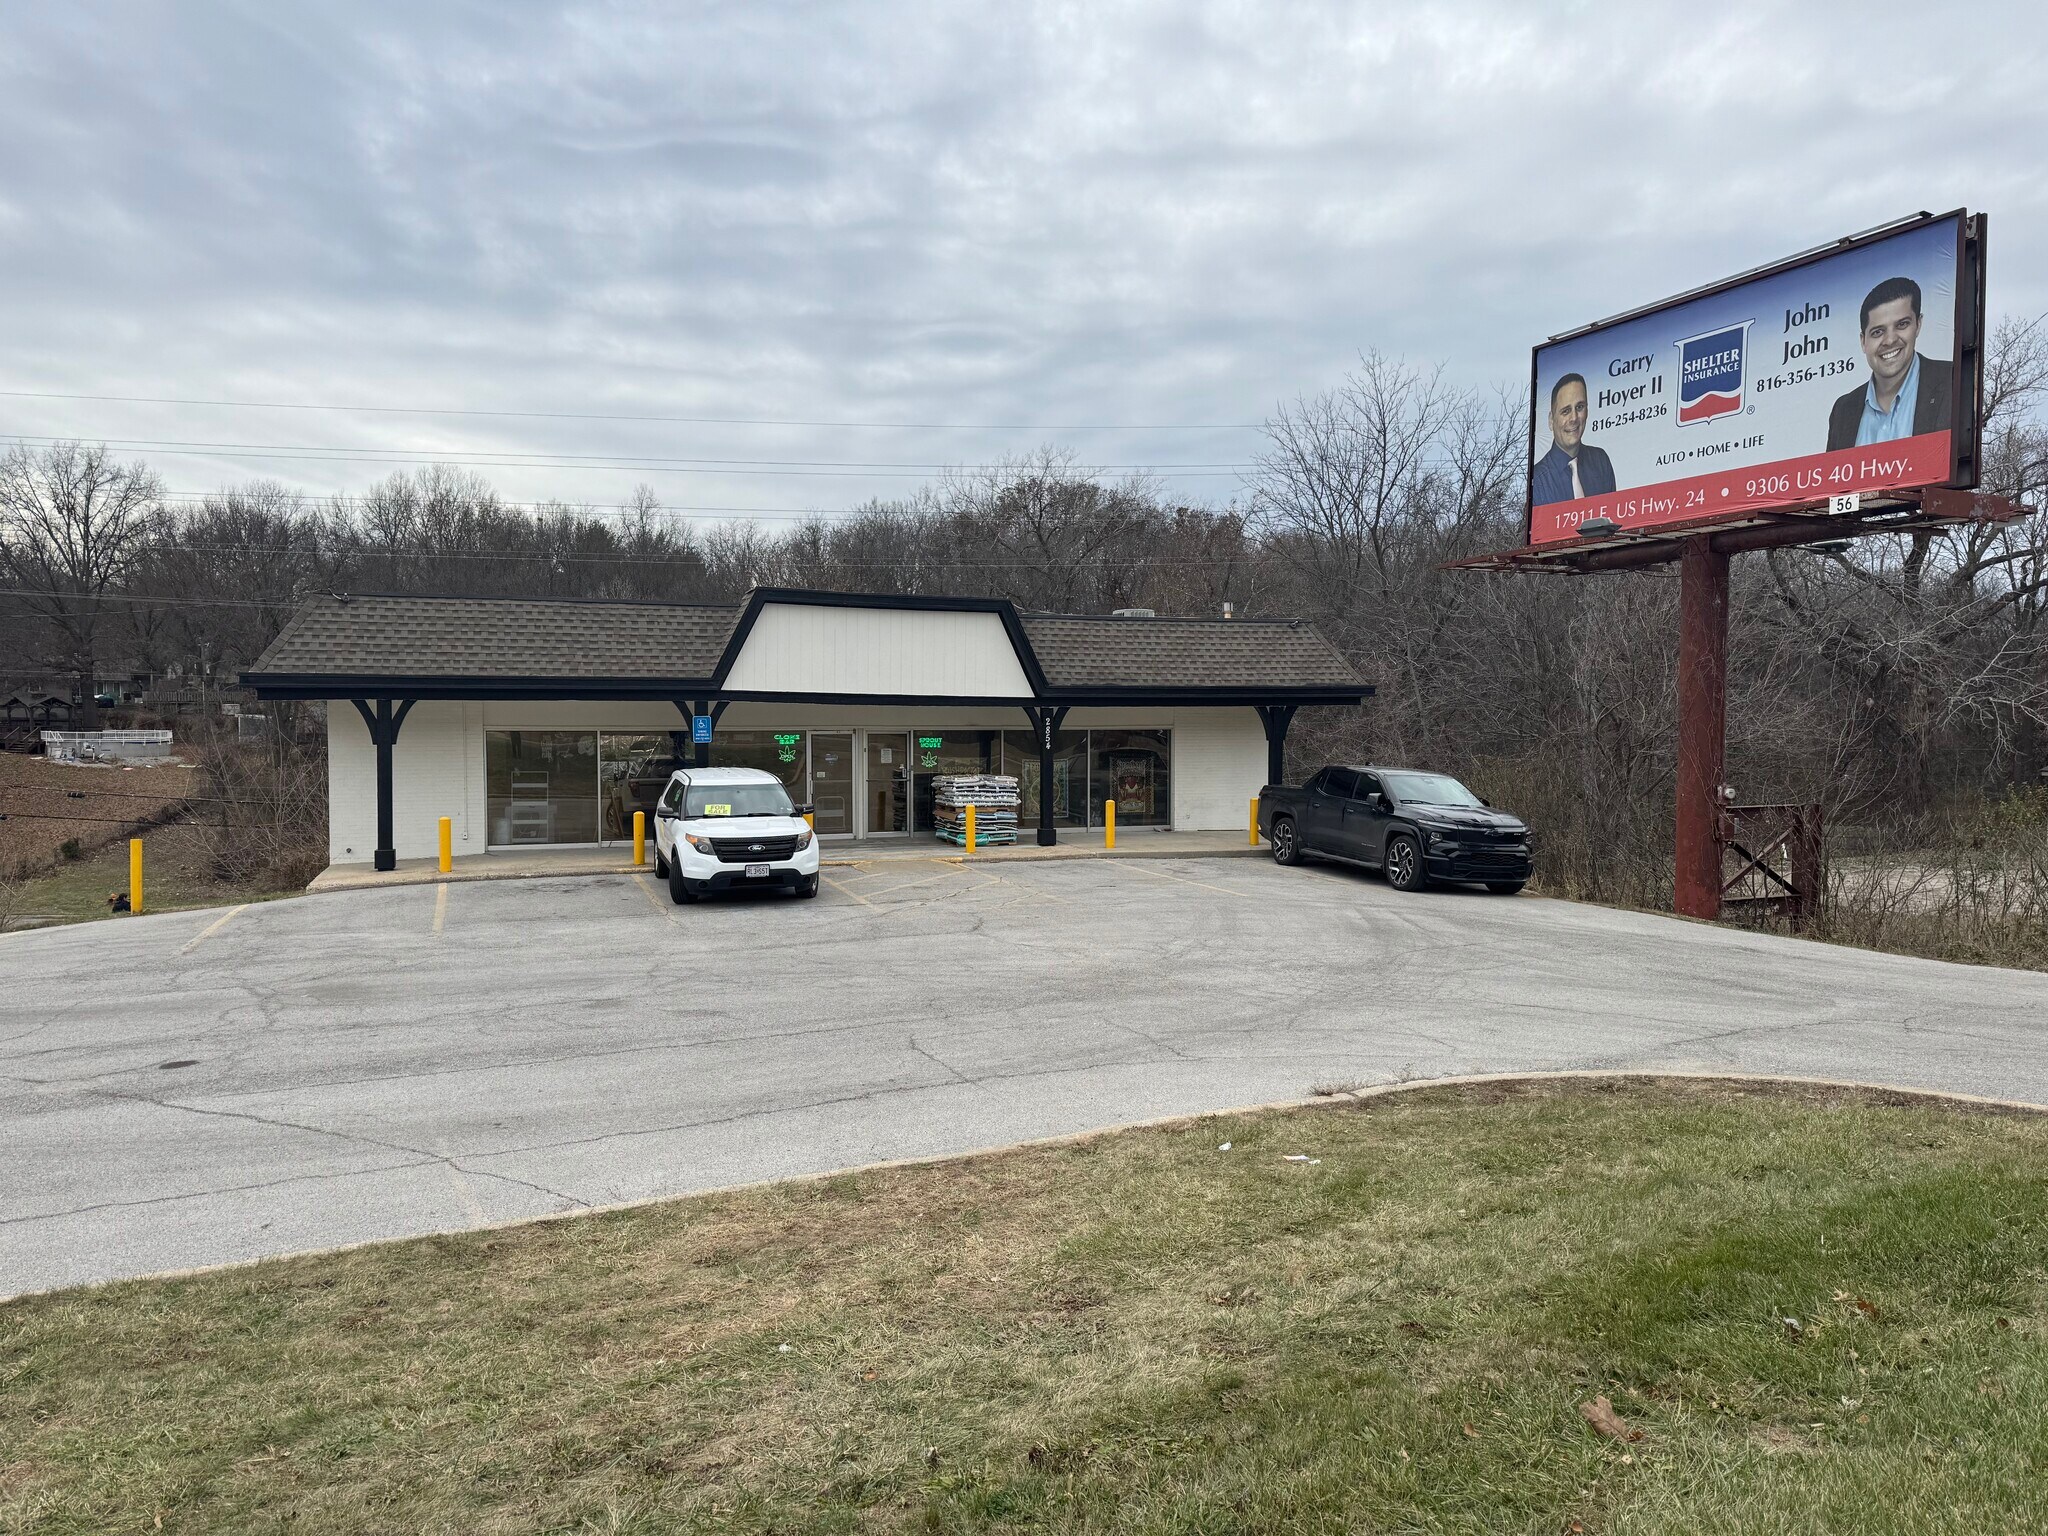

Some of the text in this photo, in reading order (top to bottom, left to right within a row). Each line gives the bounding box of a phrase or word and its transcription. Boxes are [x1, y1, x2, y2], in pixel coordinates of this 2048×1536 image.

[1783, 302, 1830, 334] John
[1608, 353, 1655, 377] Garry
[1683, 348, 1740, 374] SHELTER
[1782, 334, 1829, 366] John
[1683, 361, 1740, 384] INSURANCE
[1756, 356, 1855, 393] 816-356-1336
[1598, 375, 1662, 408] Hoyer II
[1591, 402, 1667, 432] 816-254-8236
[1655, 434, 1765, 467] AUTO HOME LIFE
[1616, 500, 1636, 519] US
[1641, 497, 1679, 515] Hwy.
[1684, 488, 1705, 508] 24
[1746, 473, 1790, 498] 9306
[1796, 467, 1822, 489] US
[1828, 463, 1853, 483] 40
[1860, 457, 1913, 479] Hwy.
[1836, 496, 1853, 512] 56
